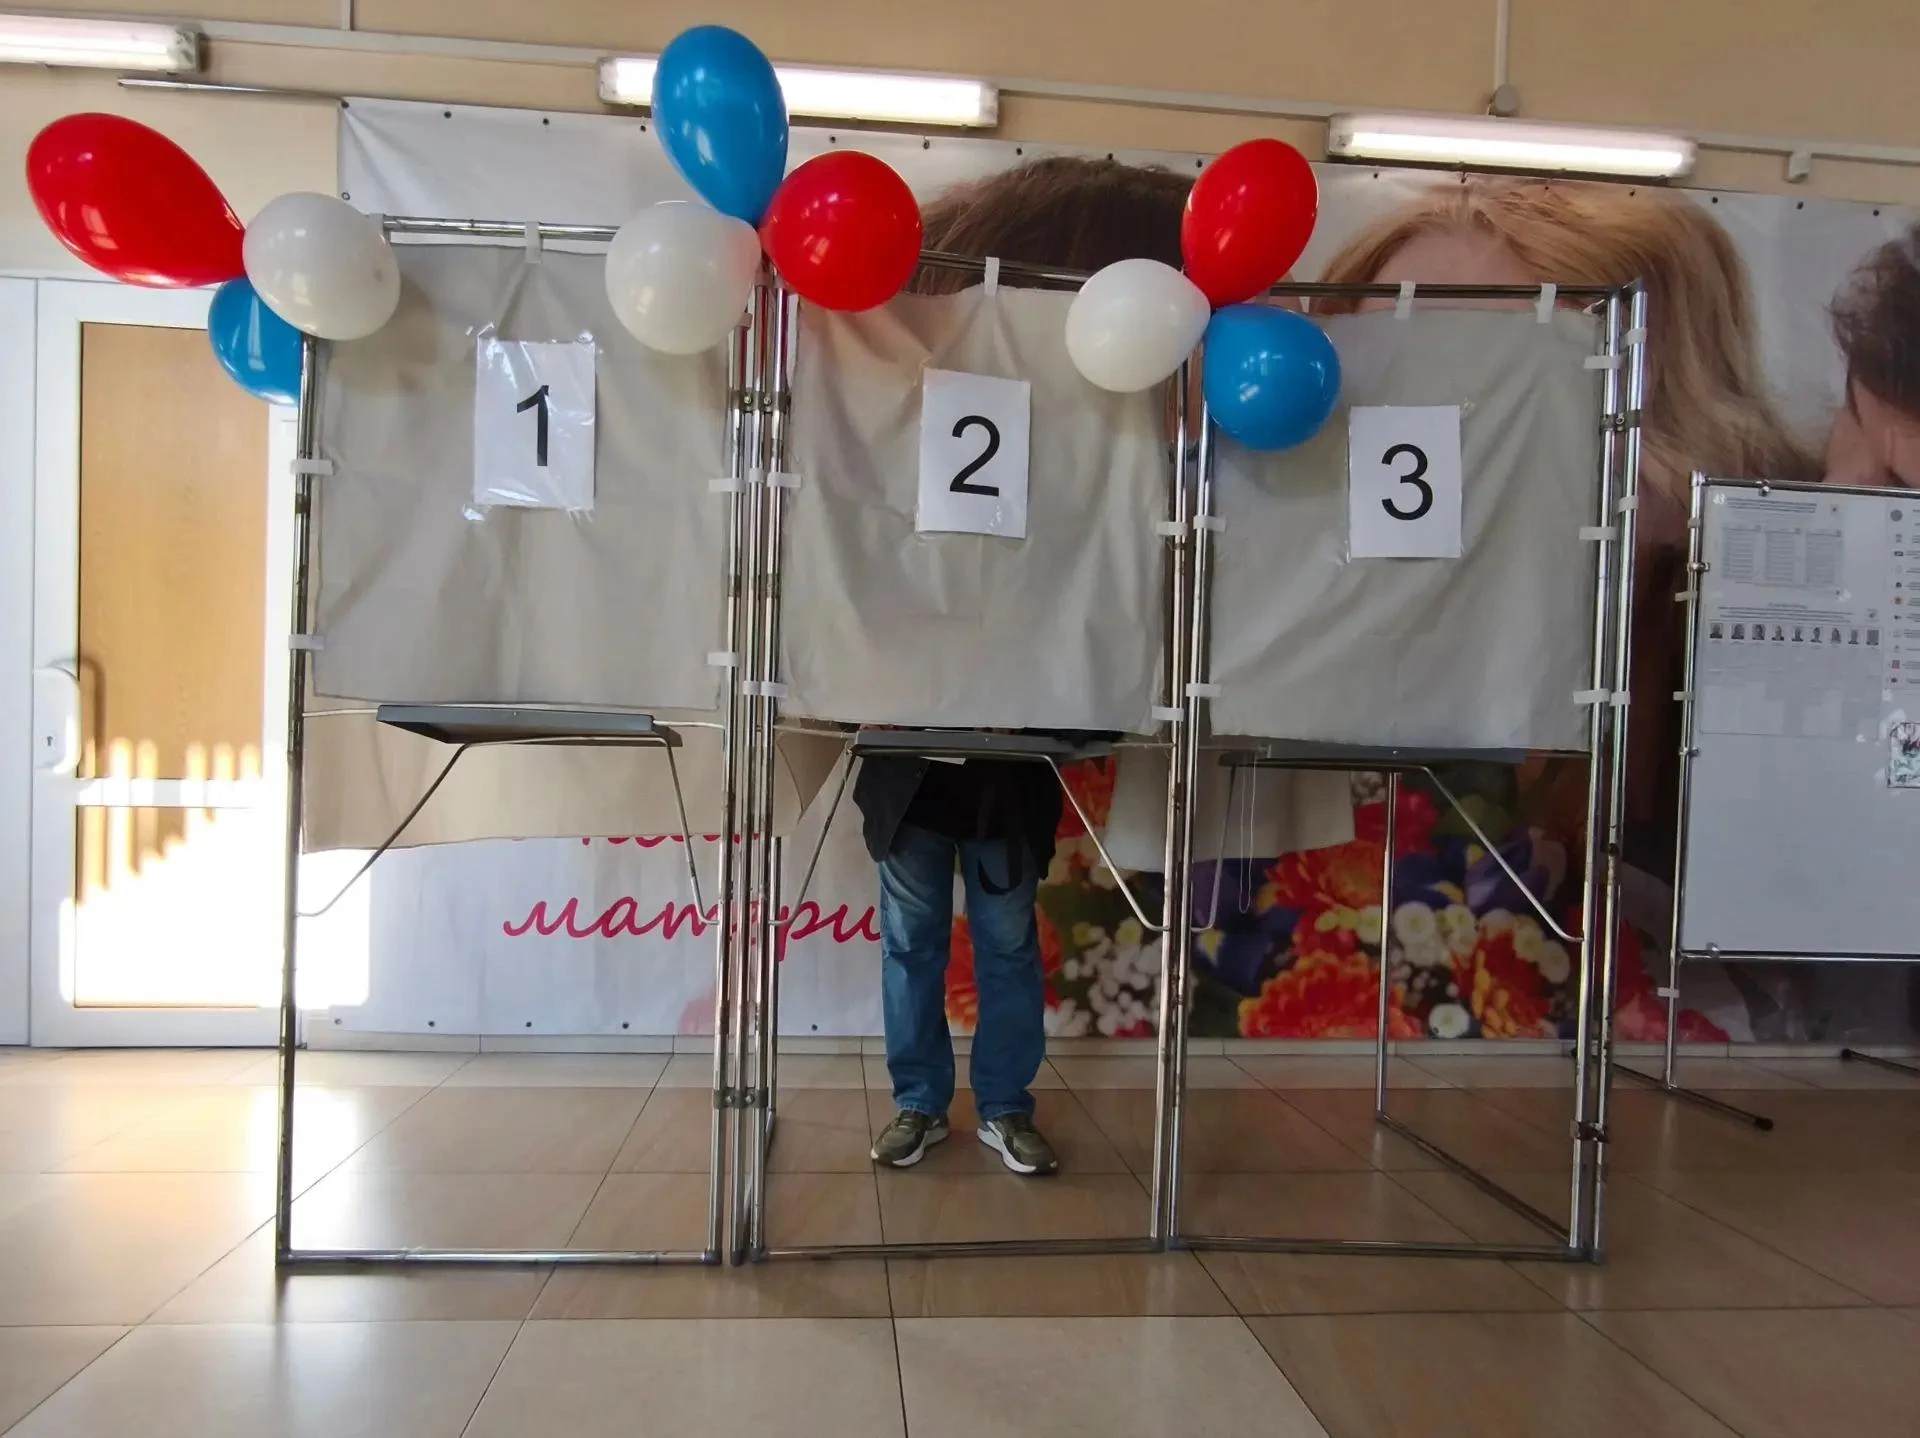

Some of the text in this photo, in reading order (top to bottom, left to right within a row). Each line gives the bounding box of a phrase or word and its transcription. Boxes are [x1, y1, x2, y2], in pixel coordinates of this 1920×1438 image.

[515, 384, 550, 468] 1
[949, 415, 1001, 498] 2
[1380, 443, 1434, 521] 3
